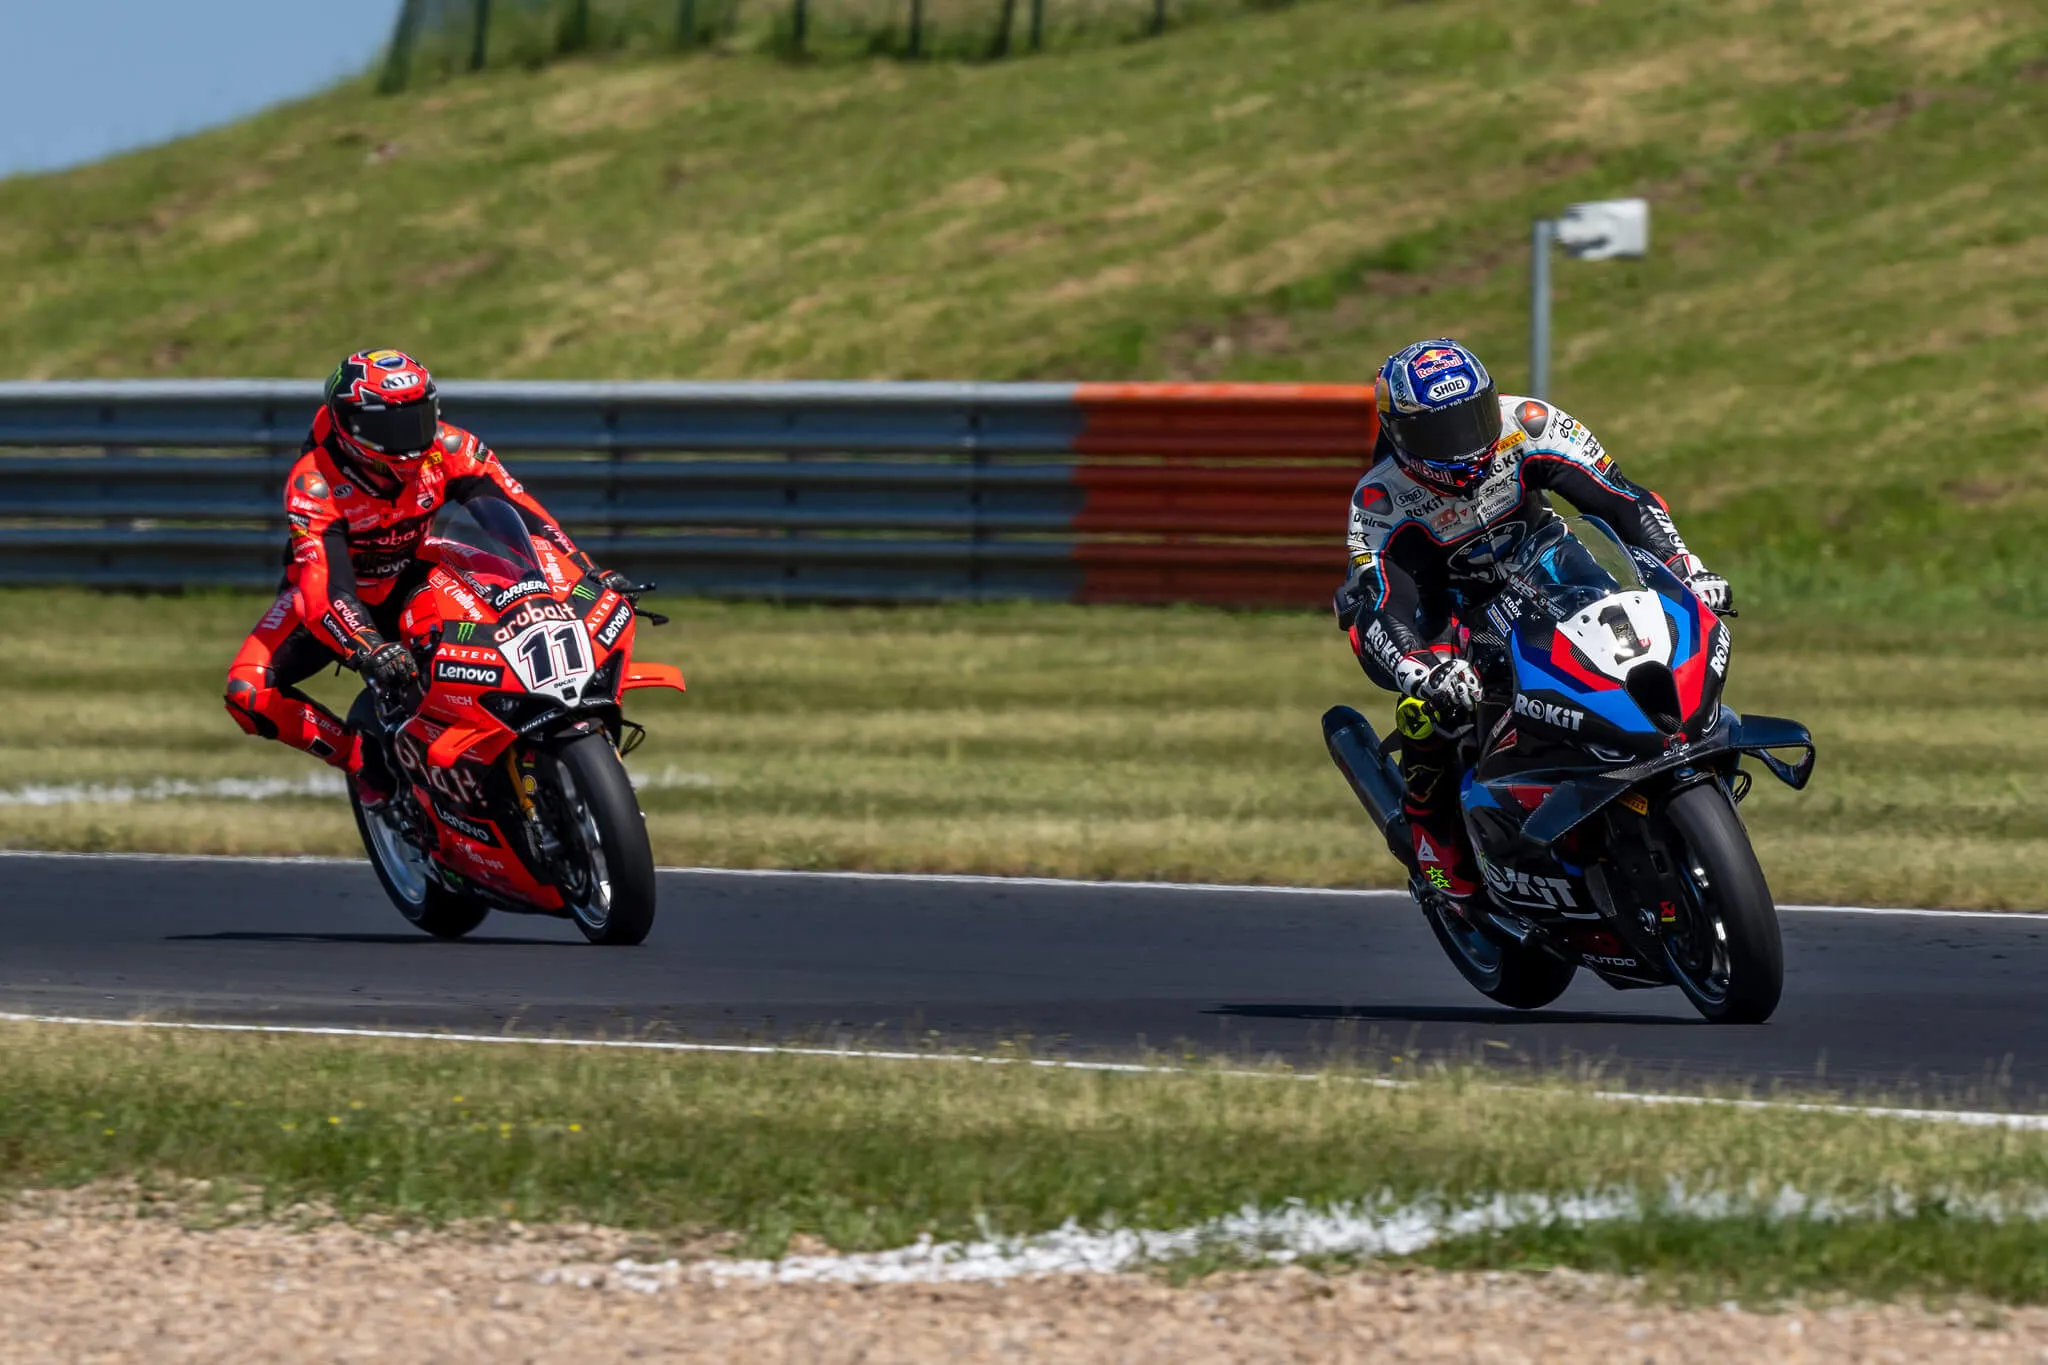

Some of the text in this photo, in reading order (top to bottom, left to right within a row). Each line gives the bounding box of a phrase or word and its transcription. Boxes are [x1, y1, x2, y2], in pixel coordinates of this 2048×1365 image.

[1440, 355, 1463, 370] Bull
[1433, 379, 1465, 397] SHOEI
[495, 580, 551, 607] CARRERA
[586, 591, 618, 633] ALTEN
[597, 604, 631, 647] Lenovo
[436, 648, 497, 662] ALTEN
[519, 624, 586, 688] 11
[438, 662, 497, 683] Lenovo
[444, 694, 473, 706] TECH
[1514, 693, 1584, 732] ROKiT
